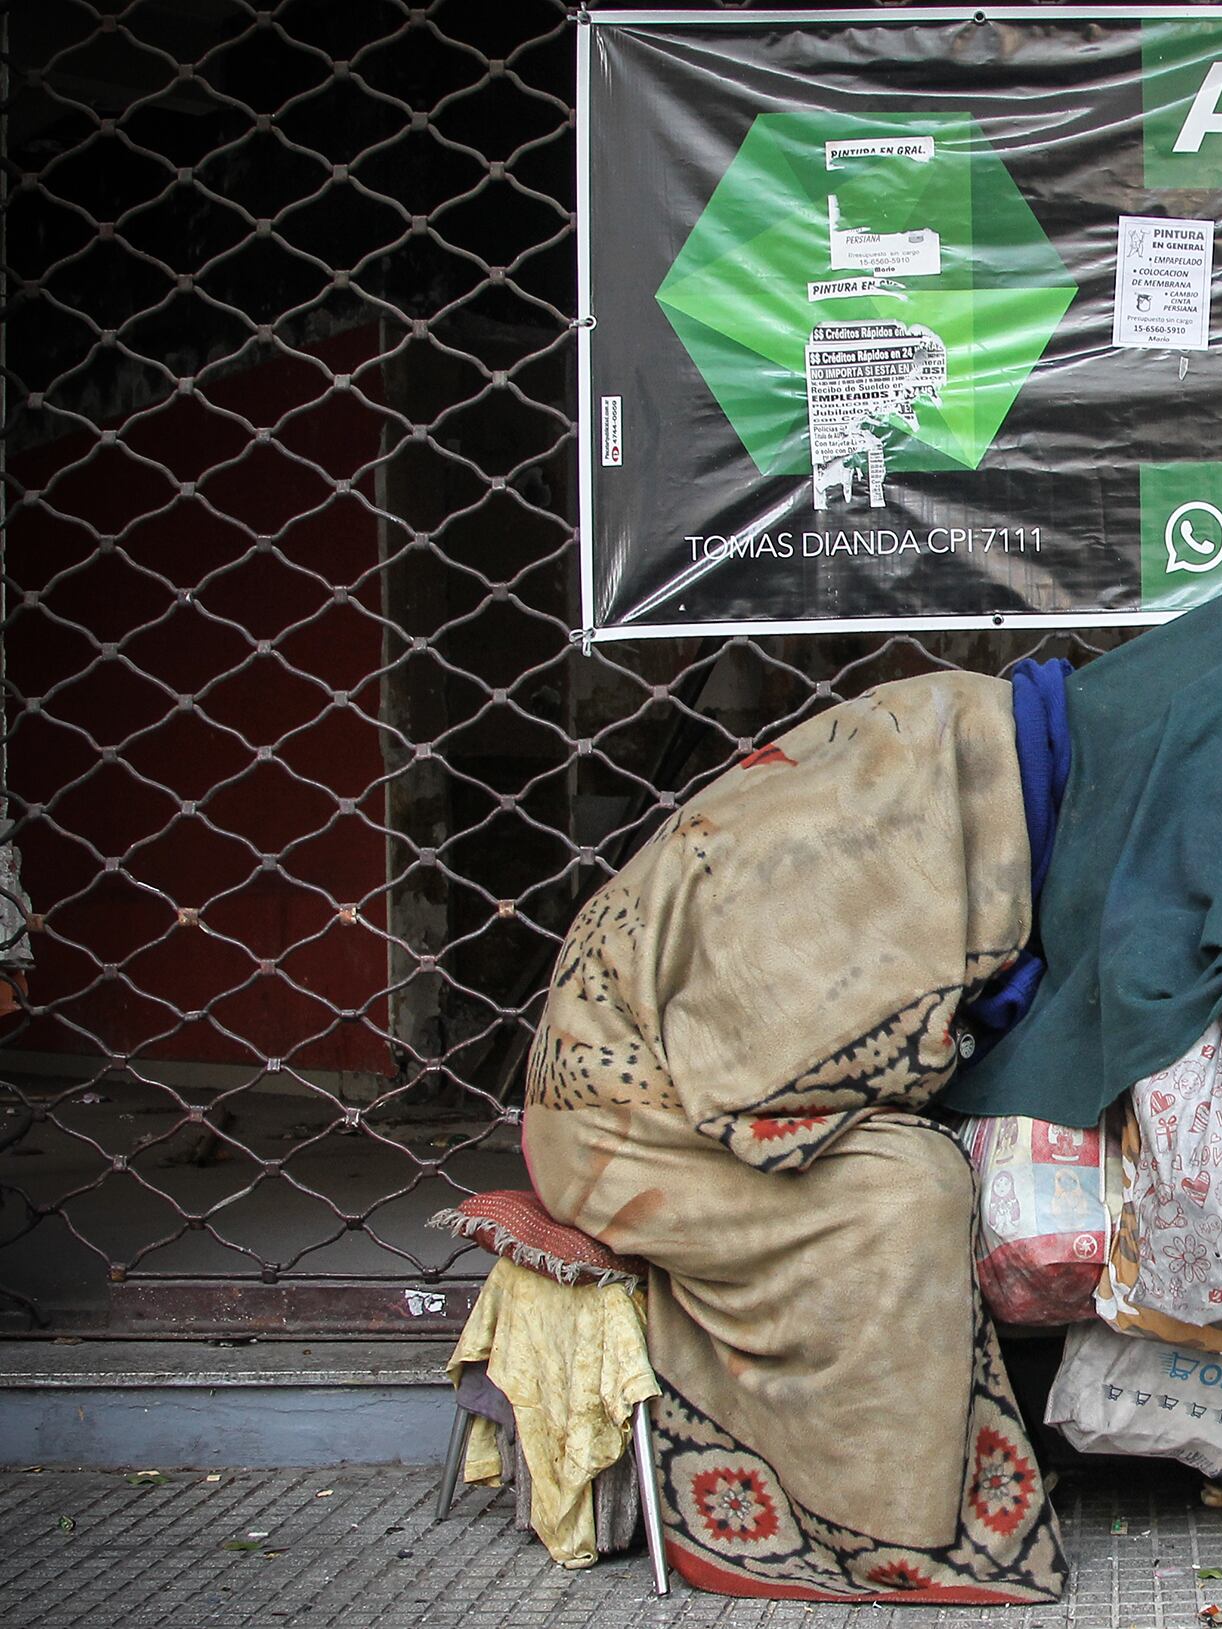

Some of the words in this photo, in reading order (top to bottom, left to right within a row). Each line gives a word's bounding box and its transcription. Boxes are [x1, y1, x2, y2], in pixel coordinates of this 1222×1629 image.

[897, 145, 926, 156] GRAL.
[845, 235, 881, 245] PERSIANA
[1153, 229, 1205, 240] PINTURA
[1152, 241, 1165, 249] EN
[1166, 242, 1205, 251] GENERAL
[1154, 256, 1203, 266] EMPAPELADO
[1139, 269, 1189, 277] COLOCACION
[812, 283, 857, 296] PINTURA
[1144, 280, 1191, 288] MEMBRANA
[1163, 305, 1198, 313] PERSIANA
[1127, 315, 1165, 323] Presupuesto
[825, 328, 860, 340] Créditos
[861, 327, 893, 339] Rápidos
[1134, 325, 1186, 334] 15-6560-5910
[822, 352, 856, 363] Créditos
[857, 350, 889, 362] Rápidos
[890, 351, 901, 359] en
[902, 349, 912, 358] 24
[811, 369, 824, 380] NO
[825, 367, 863, 378] IMPORTA
[865, 366, 873, 376] SI
[874, 365, 897, 375] ESTA
[898, 364, 910, 374] EN
[811, 385, 842, 394] Recibo
[847, 384, 856, 392] de
[859, 382, 890, 391] Sueldo
[812, 391, 889, 402] EMPLEADOS
[684, 532, 794, 562] TOMAS
[802, 530, 921, 559] DIANDA
[927, 528, 973, 554] CPI
[981, 527, 1042, 554] 7111
